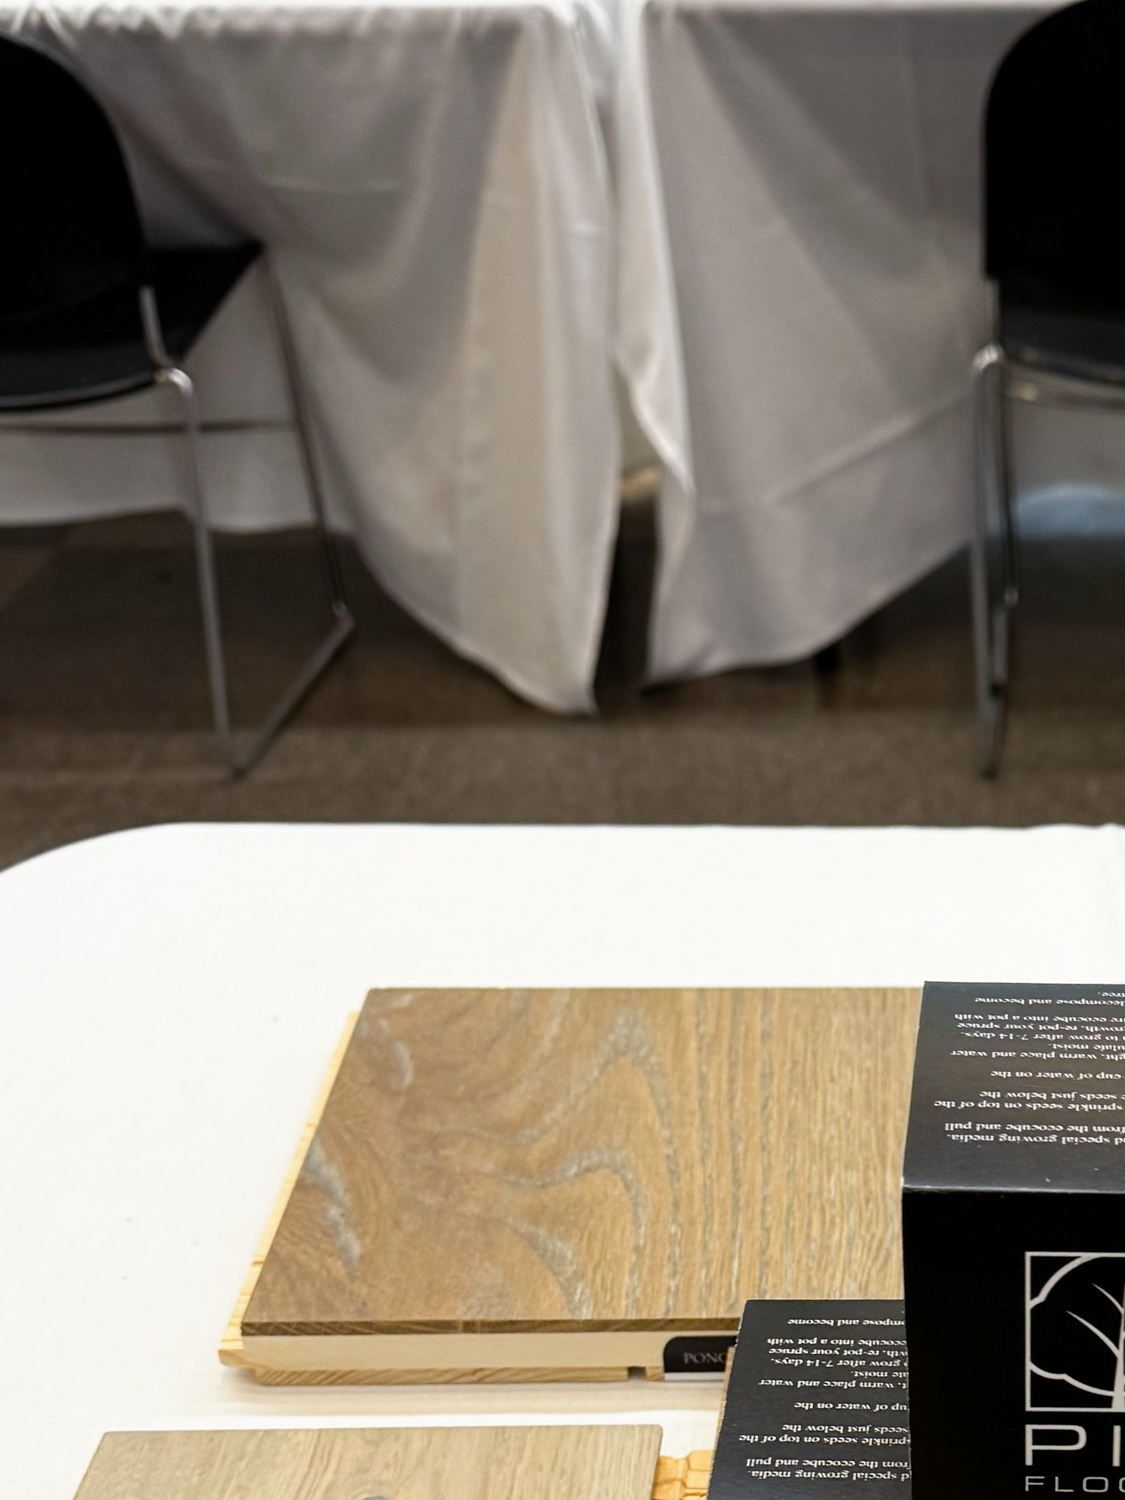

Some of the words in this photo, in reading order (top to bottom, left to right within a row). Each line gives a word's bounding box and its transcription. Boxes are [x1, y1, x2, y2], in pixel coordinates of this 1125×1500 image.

[1095, 1071, 1121, 1079] cup
[979, 1091, 1001, 1099] the
[1006, 1091, 1046, 1100] below
[1051, 1090, 1075, 1099] just
[1079, 1093, 1117, 1101] seeds
[933, 1100, 955, 1108] the
[959, 1101, 974, 1109] of
[977, 1099, 1000, 1108] top
[1025, 1102, 1063, 1110] seeds
[1067, 1101, 1122, 1112] sprinkle
[944, 1120, 972, 1130] pull
[975, 1123, 1001, 1131] and
[1005, 1124, 1063, 1132] ecocube
[1066, 1125, 1088, 1133] the
[1092, 1125, 1125, 1134] from
[998, 1133, 1057, 1143] growing
[1061, 1134, 1110, 1145] special
[757, 1379, 794, 1387] water
[796, 1380, 820, 1388] and
[822, 1378, 856, 1389] place
[793, 1402, 813, 1410] the
[874, 1403, 888, 1411] of
[781, 1424, 802, 1433] the
[804, 1425, 844, 1433] below
[847, 1423, 870, 1433] just
[873, 1426, 908, 1435] seeds
[738, 1435, 758, 1443] the
[760, 1435, 776, 1444] of
[778, 1433, 800, 1443] top
[822, 1436, 858, 1445] seeds
[745, 1456, 772, 1467] pull
[774, 1459, 799, 1467] and
[801, 1459, 855, 1468] ecocube
[858, 1460, 878, 1469] the
[794, 1469, 849, 1479] growing
[852, 1470, 897, 1481] special
